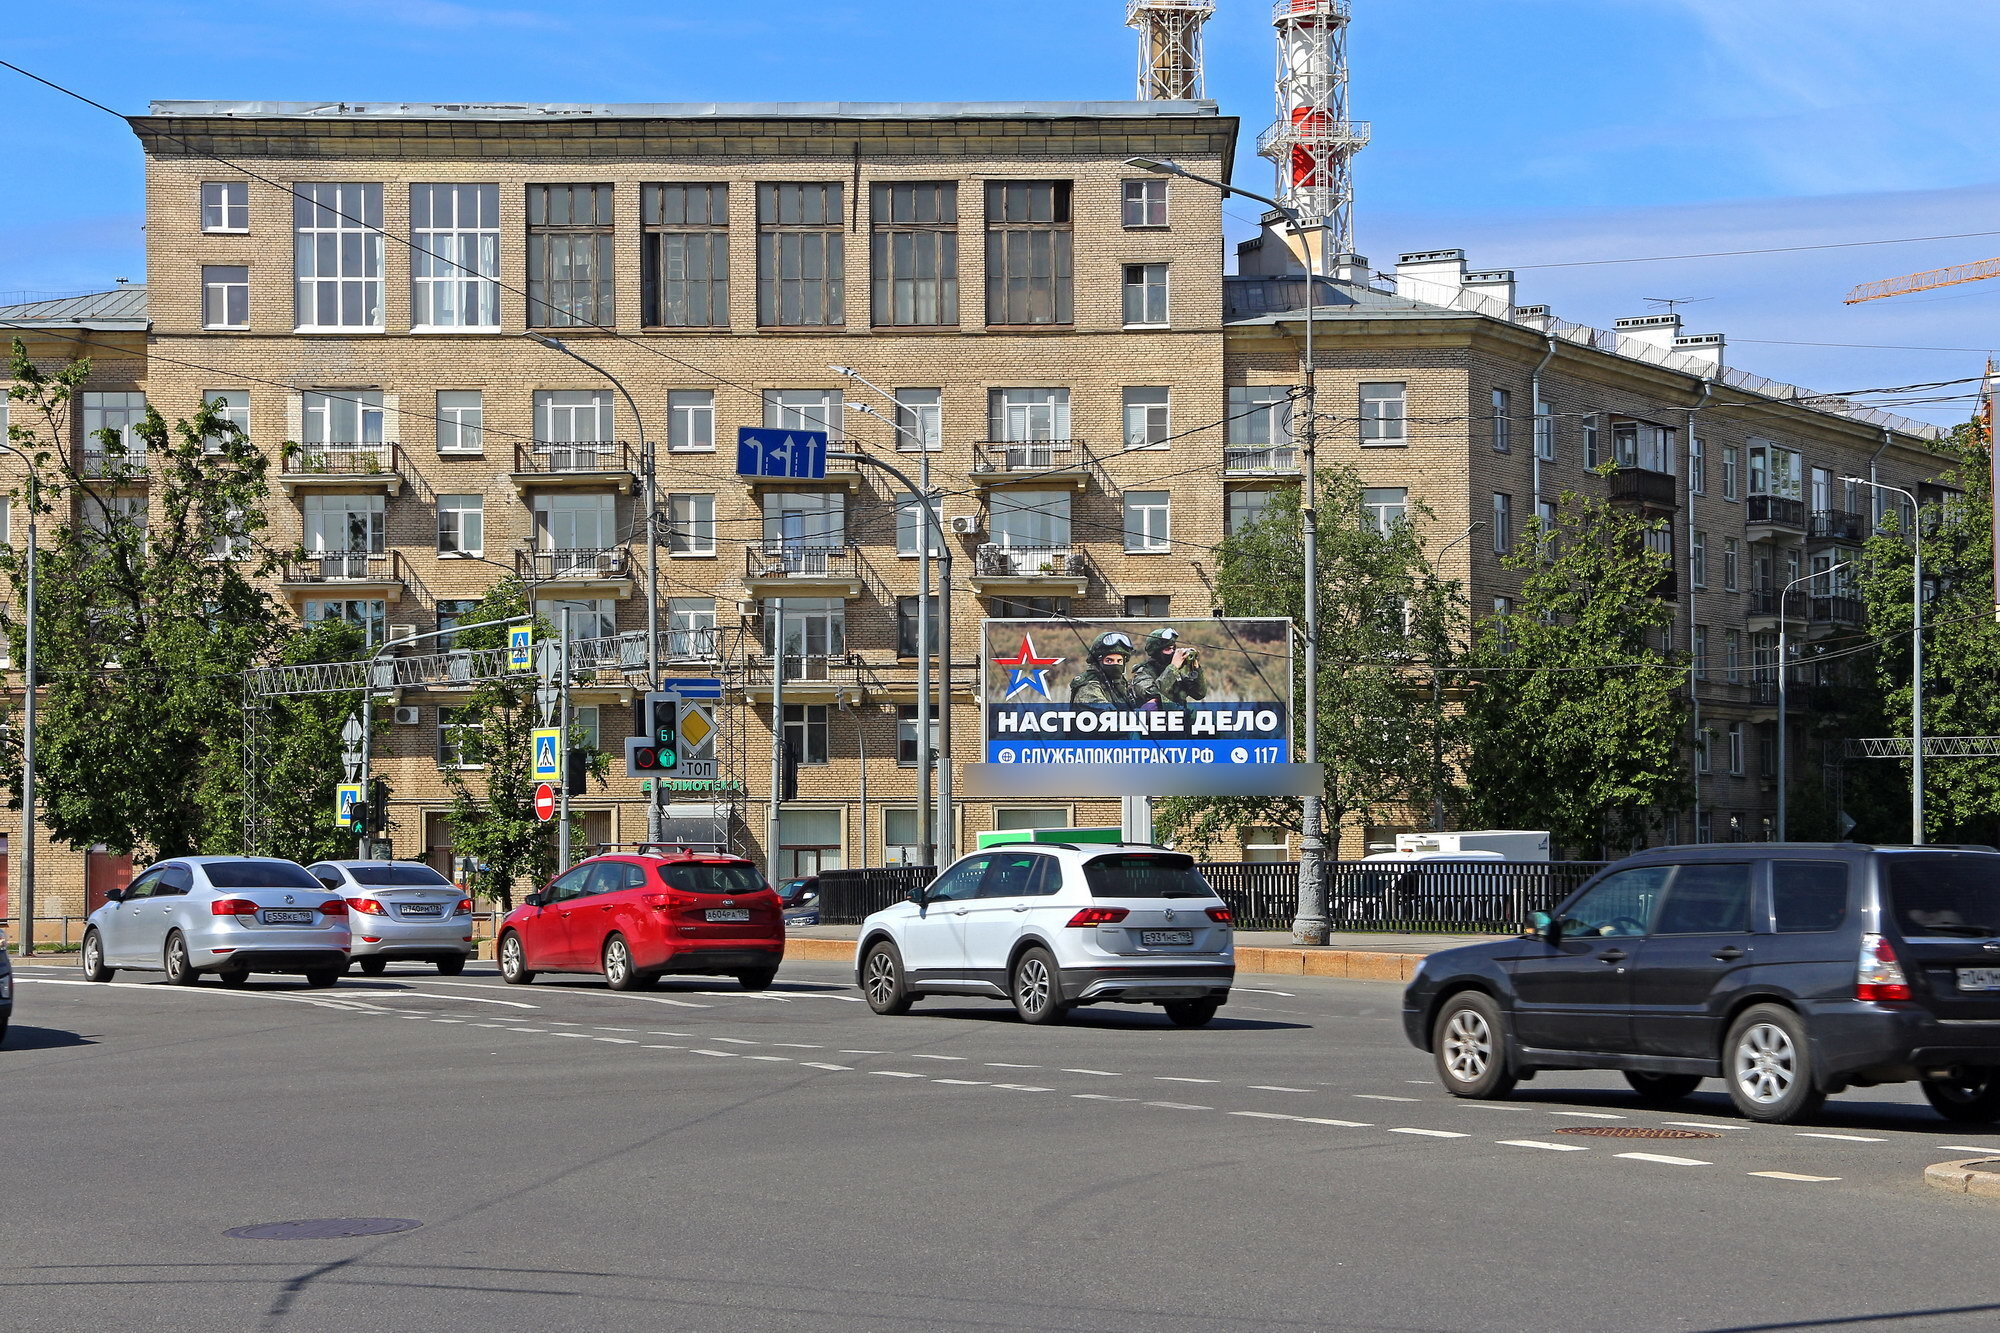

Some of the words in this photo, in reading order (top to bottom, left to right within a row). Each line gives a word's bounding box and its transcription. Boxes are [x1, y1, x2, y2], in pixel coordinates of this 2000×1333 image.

[998, 711, 1185, 735] НАСТОЯЩЕЕ
[1191, 710, 1278, 735] ДЕЛО
[1021, 747, 1214, 763] СЛУЖБАПОКОНТРАКТУ.РФ
[1254, 747, 1278, 763] 117
[643, 780, 740, 791] ББЛИОТЕКА
